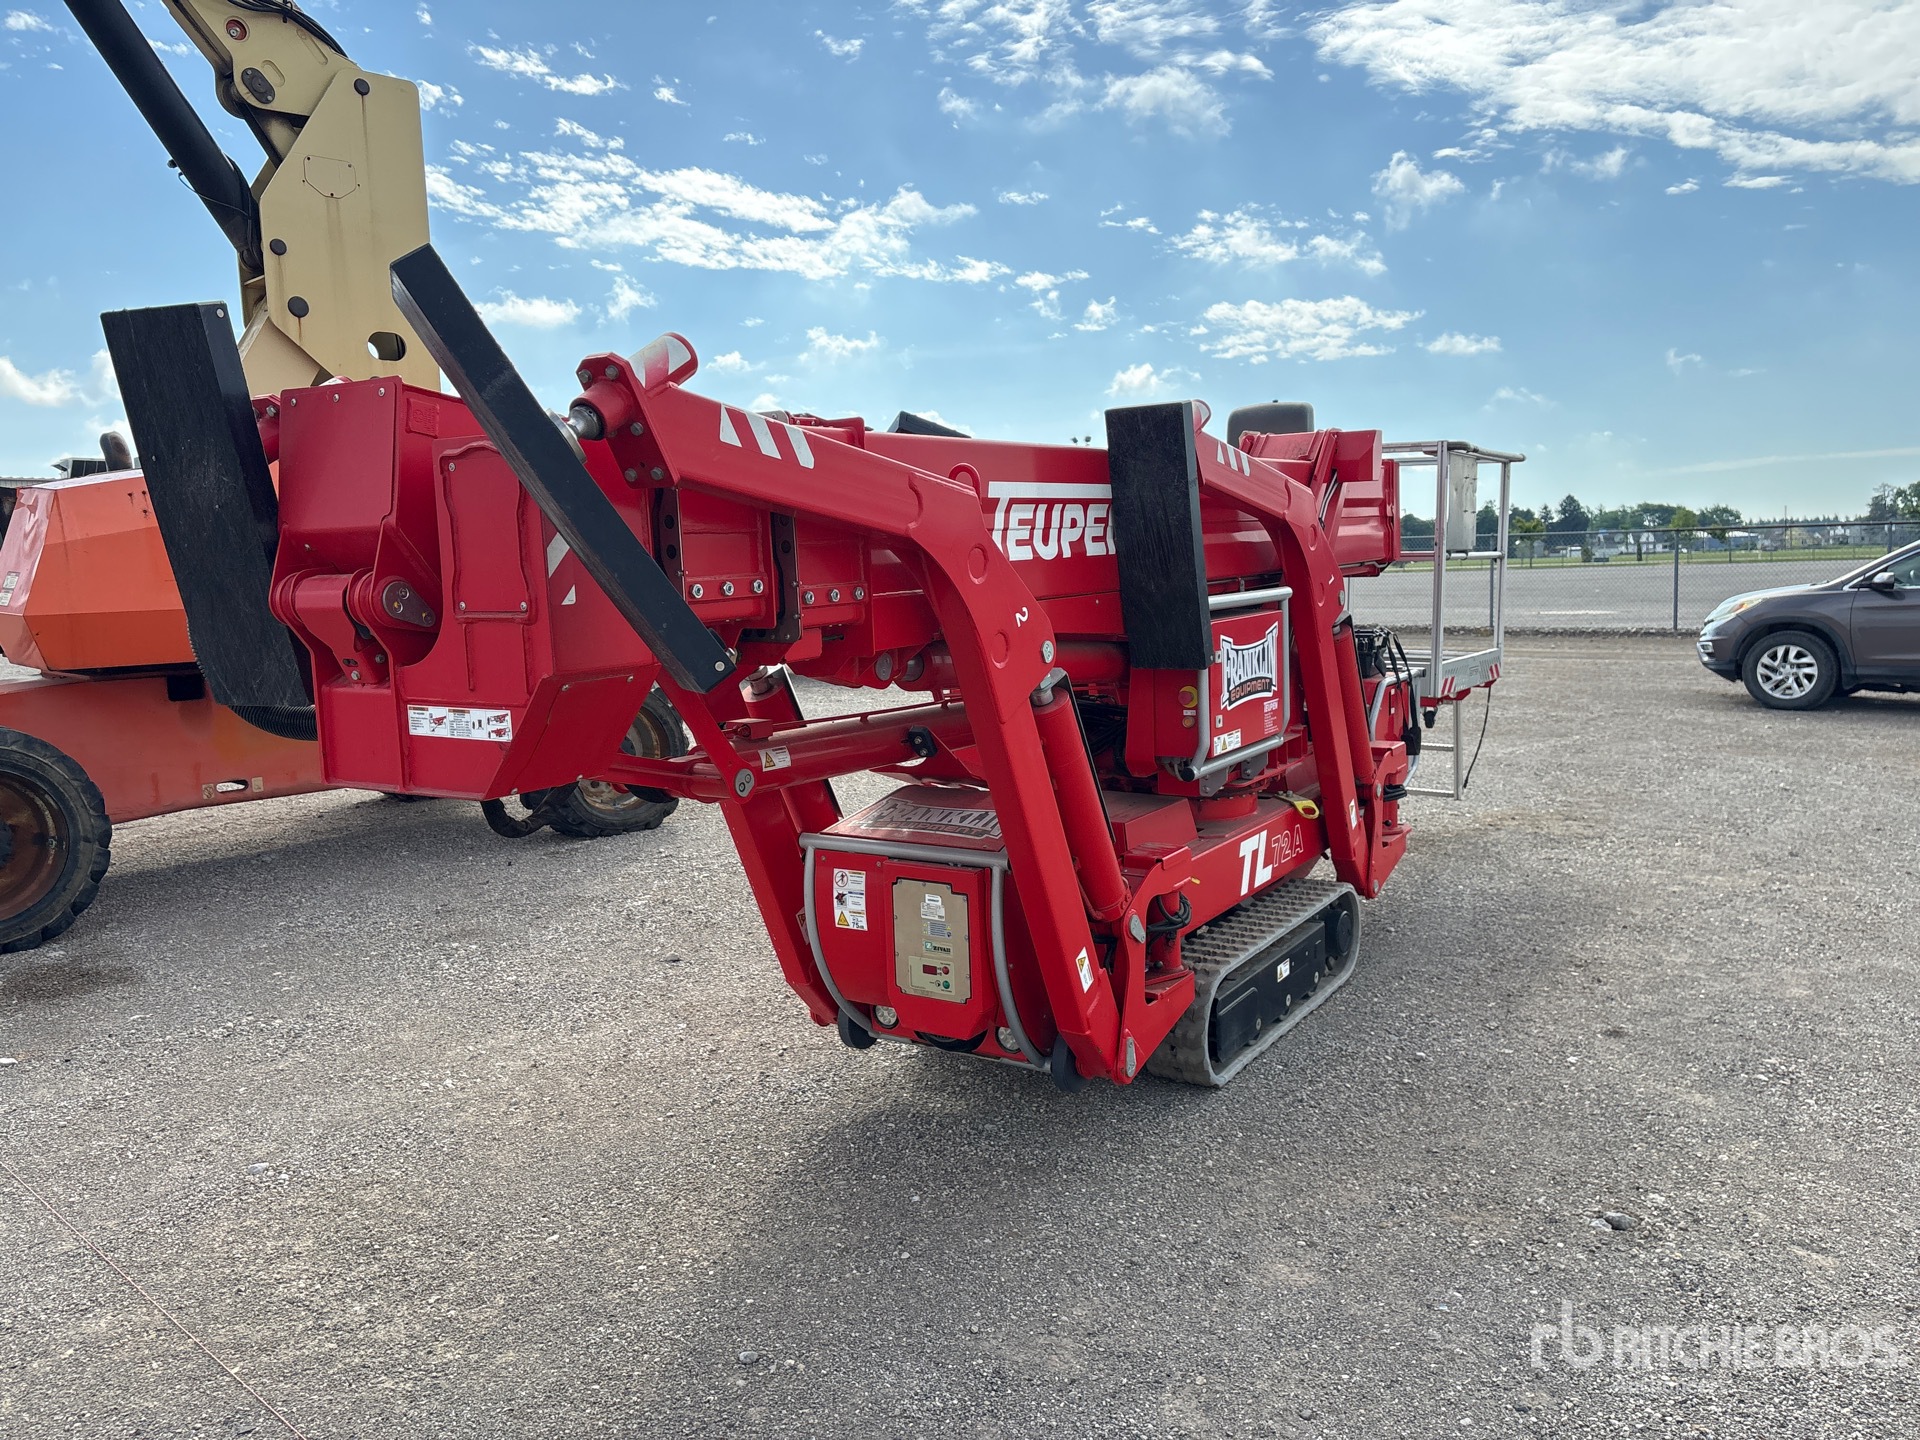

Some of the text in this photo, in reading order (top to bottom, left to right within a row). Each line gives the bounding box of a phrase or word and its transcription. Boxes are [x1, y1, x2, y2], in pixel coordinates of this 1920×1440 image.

[1015, 606, 1029, 628] 2
[1222, 627, 1277, 703] FRANKLIN
[1231, 679, 1270, 701] EQUIPMENT
[1239, 824, 1304, 897] TL 72A
